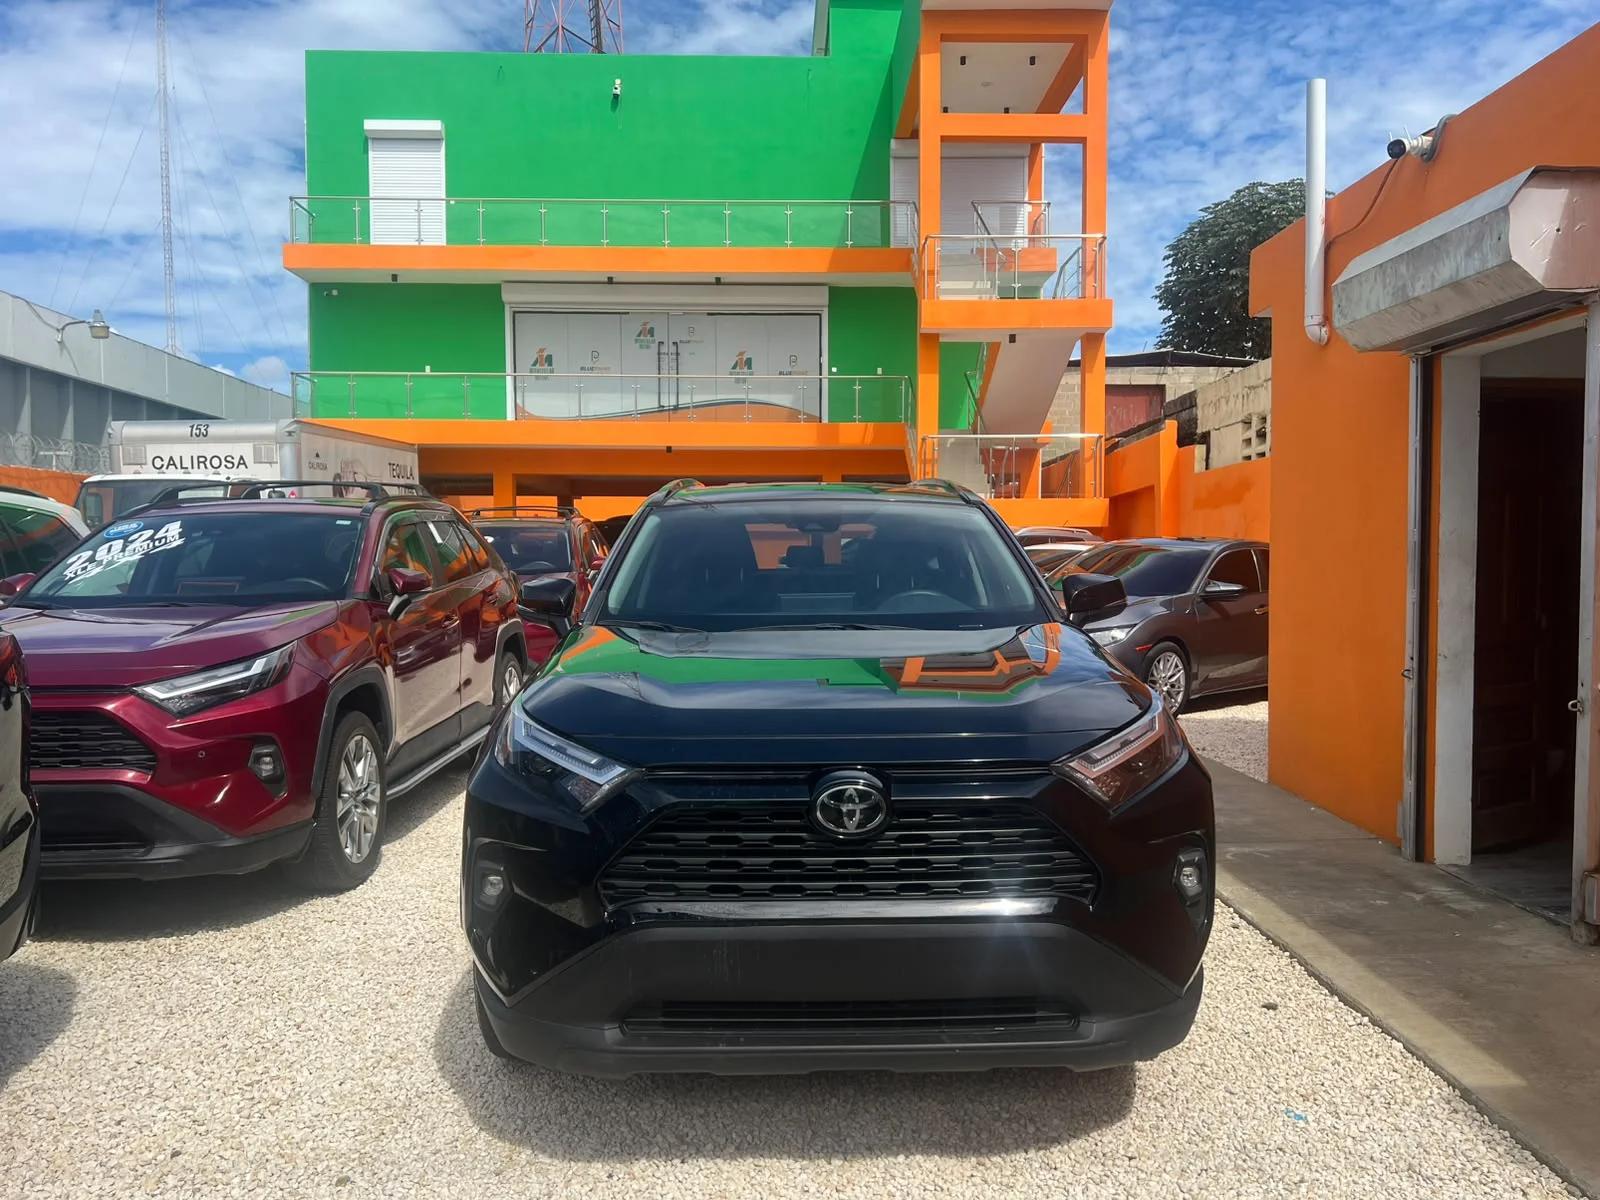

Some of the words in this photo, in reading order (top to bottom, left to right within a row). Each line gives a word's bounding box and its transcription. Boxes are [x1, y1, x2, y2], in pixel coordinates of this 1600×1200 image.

[188, 423, 210, 438] 153
[151, 455, 248, 470] CALIROSA
[388, 462, 415, 480] TEQUILA
[63, 520, 182, 575] 2024
[102, 533, 180, 565] PREMIUM
